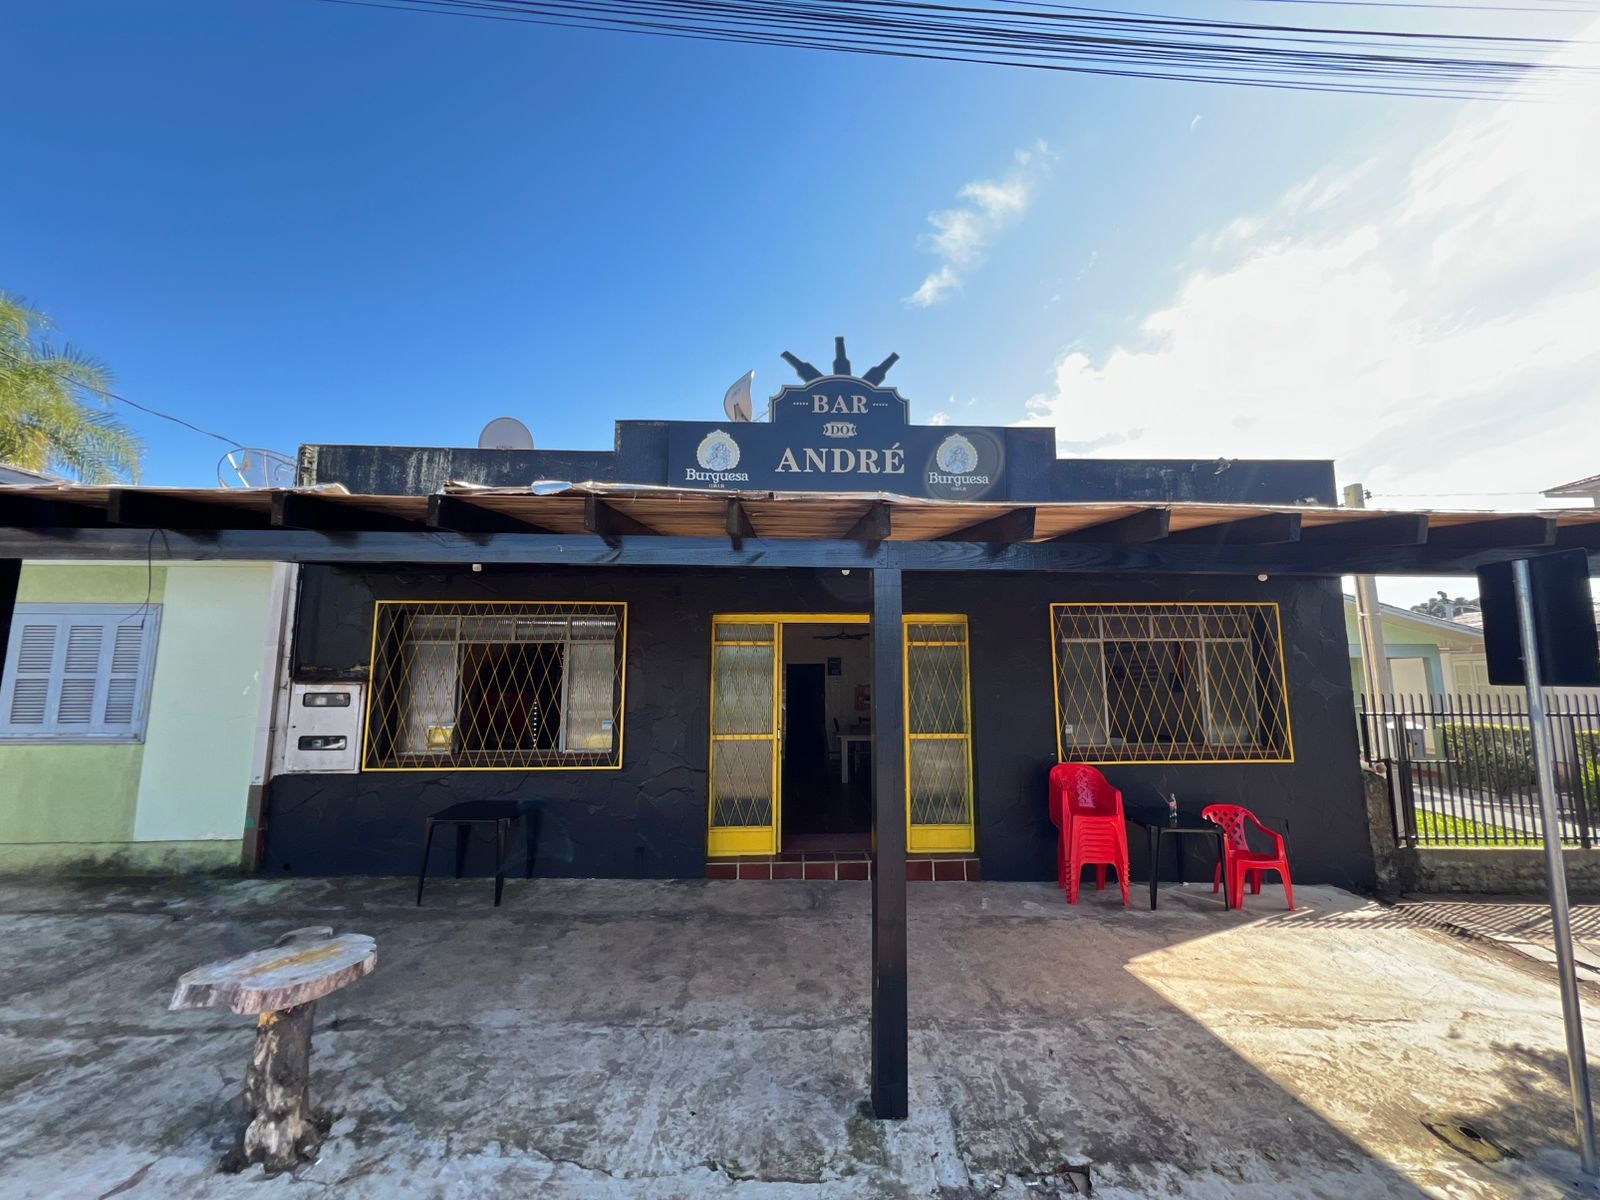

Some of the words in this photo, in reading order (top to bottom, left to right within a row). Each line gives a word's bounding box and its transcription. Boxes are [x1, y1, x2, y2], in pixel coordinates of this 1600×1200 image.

[811, 394, 869, 414] BAR
[830, 424, 850, 435] DO
[774, 442, 905, 474] ANDRÉ
[685, 468, 749, 484] Burguesa
[928, 471, 989, 487] Burguesa
